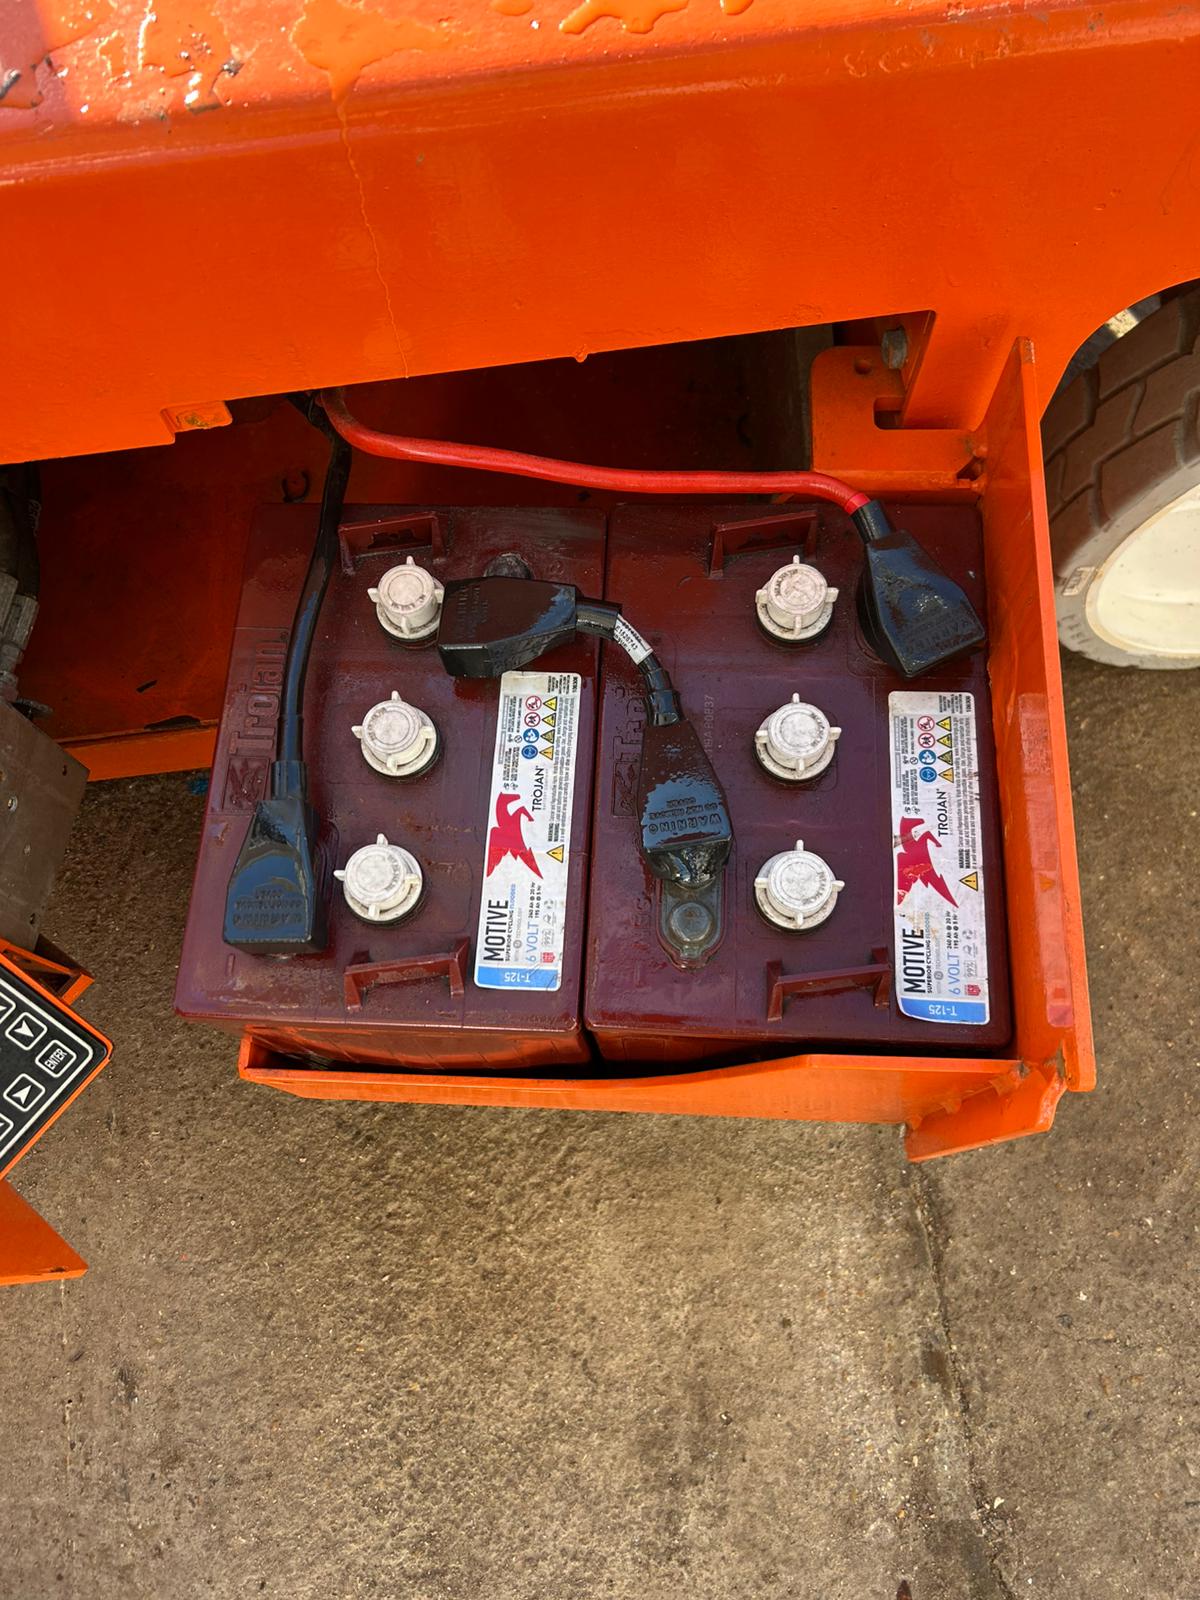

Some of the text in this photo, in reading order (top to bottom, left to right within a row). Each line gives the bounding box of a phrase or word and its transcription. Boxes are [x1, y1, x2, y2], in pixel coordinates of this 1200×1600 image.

[531, 767, 544, 812] TROJAN
[647, 813, 721, 835] WARNING
[936, 791, 948, 836] TROJAN
[483, 899, 508, 961] MOTIVE
[526, 921, 538, 952] VOLT
[504, 970, 531, 982] T-125
[901, 927, 925, 993] MOTIVE
[947, 951, 959, 984] VOLT
[928, 1003, 956, 1016] T-125
[44, 1048, 68, 1070] ENTER
